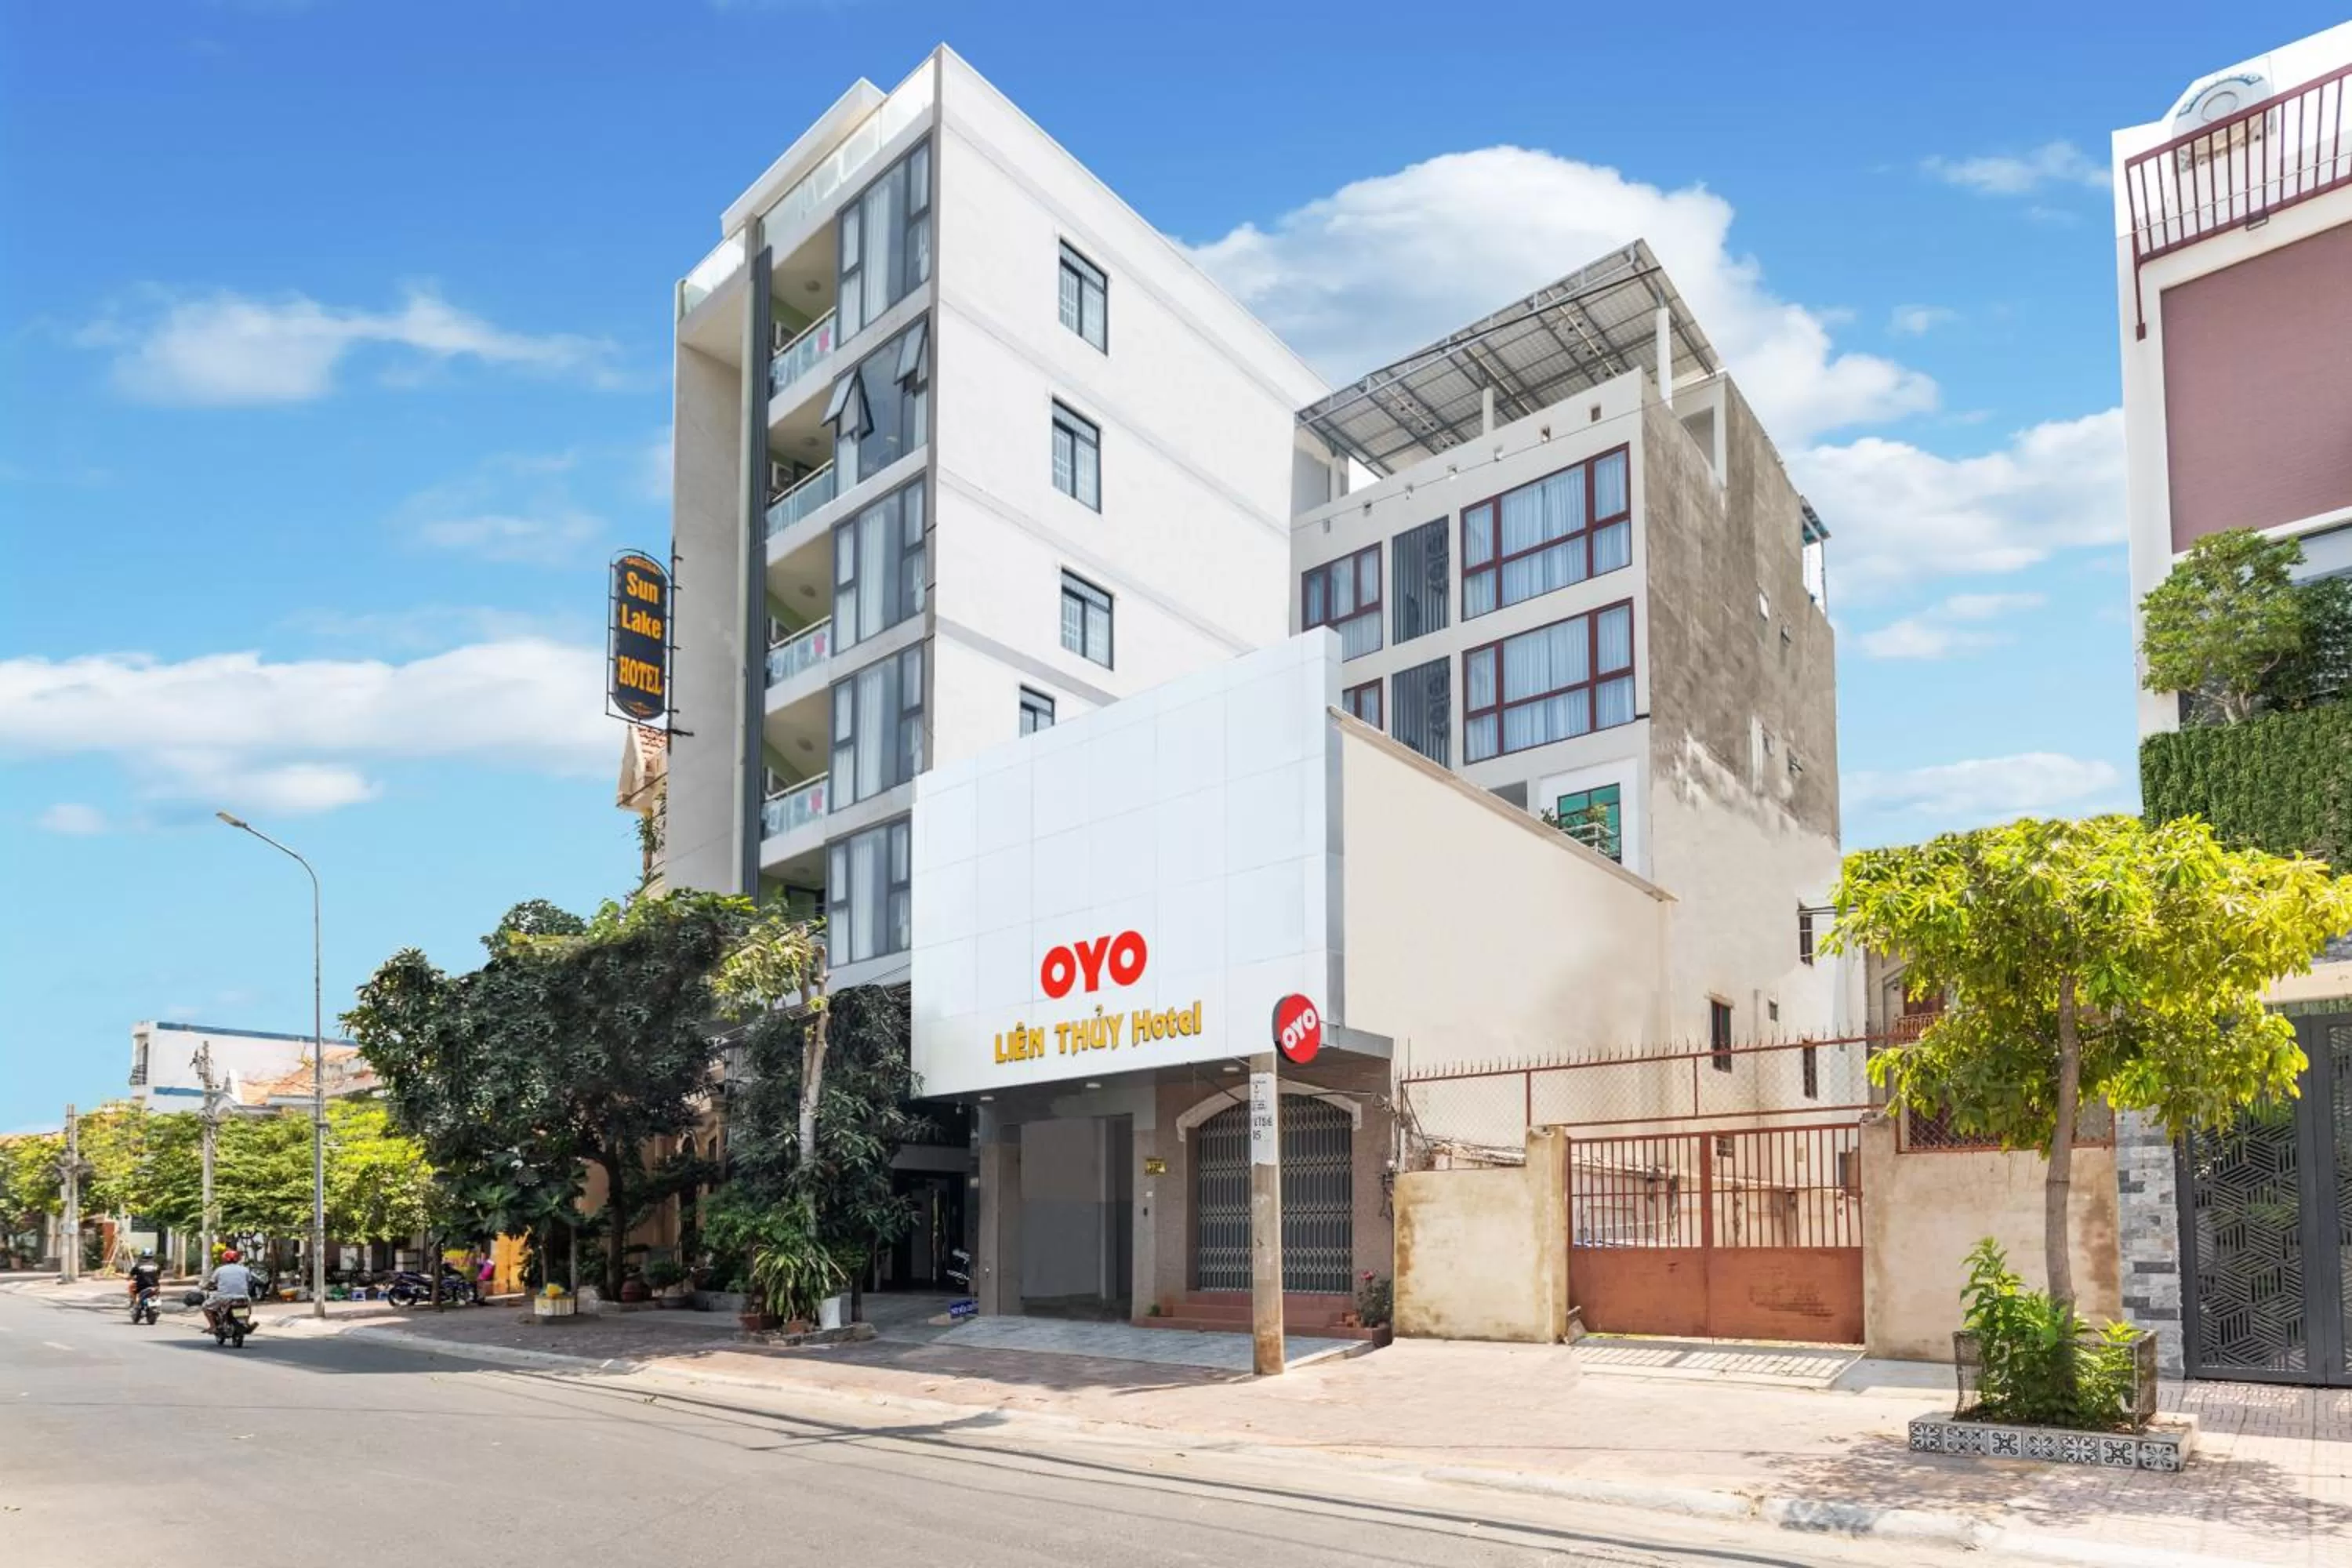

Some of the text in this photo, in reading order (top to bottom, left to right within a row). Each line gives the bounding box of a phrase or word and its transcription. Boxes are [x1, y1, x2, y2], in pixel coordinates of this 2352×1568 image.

[626, 571, 659, 604] Sun
[621, 604, 662, 640] Lake
[619, 655, 662, 695] HOTEL
[1040, 930, 1147, 999] OYO
[994, 1000, 1202, 1064] LIÊN THỦY Hotel
[1282, 1008, 1316, 1049] OYO
